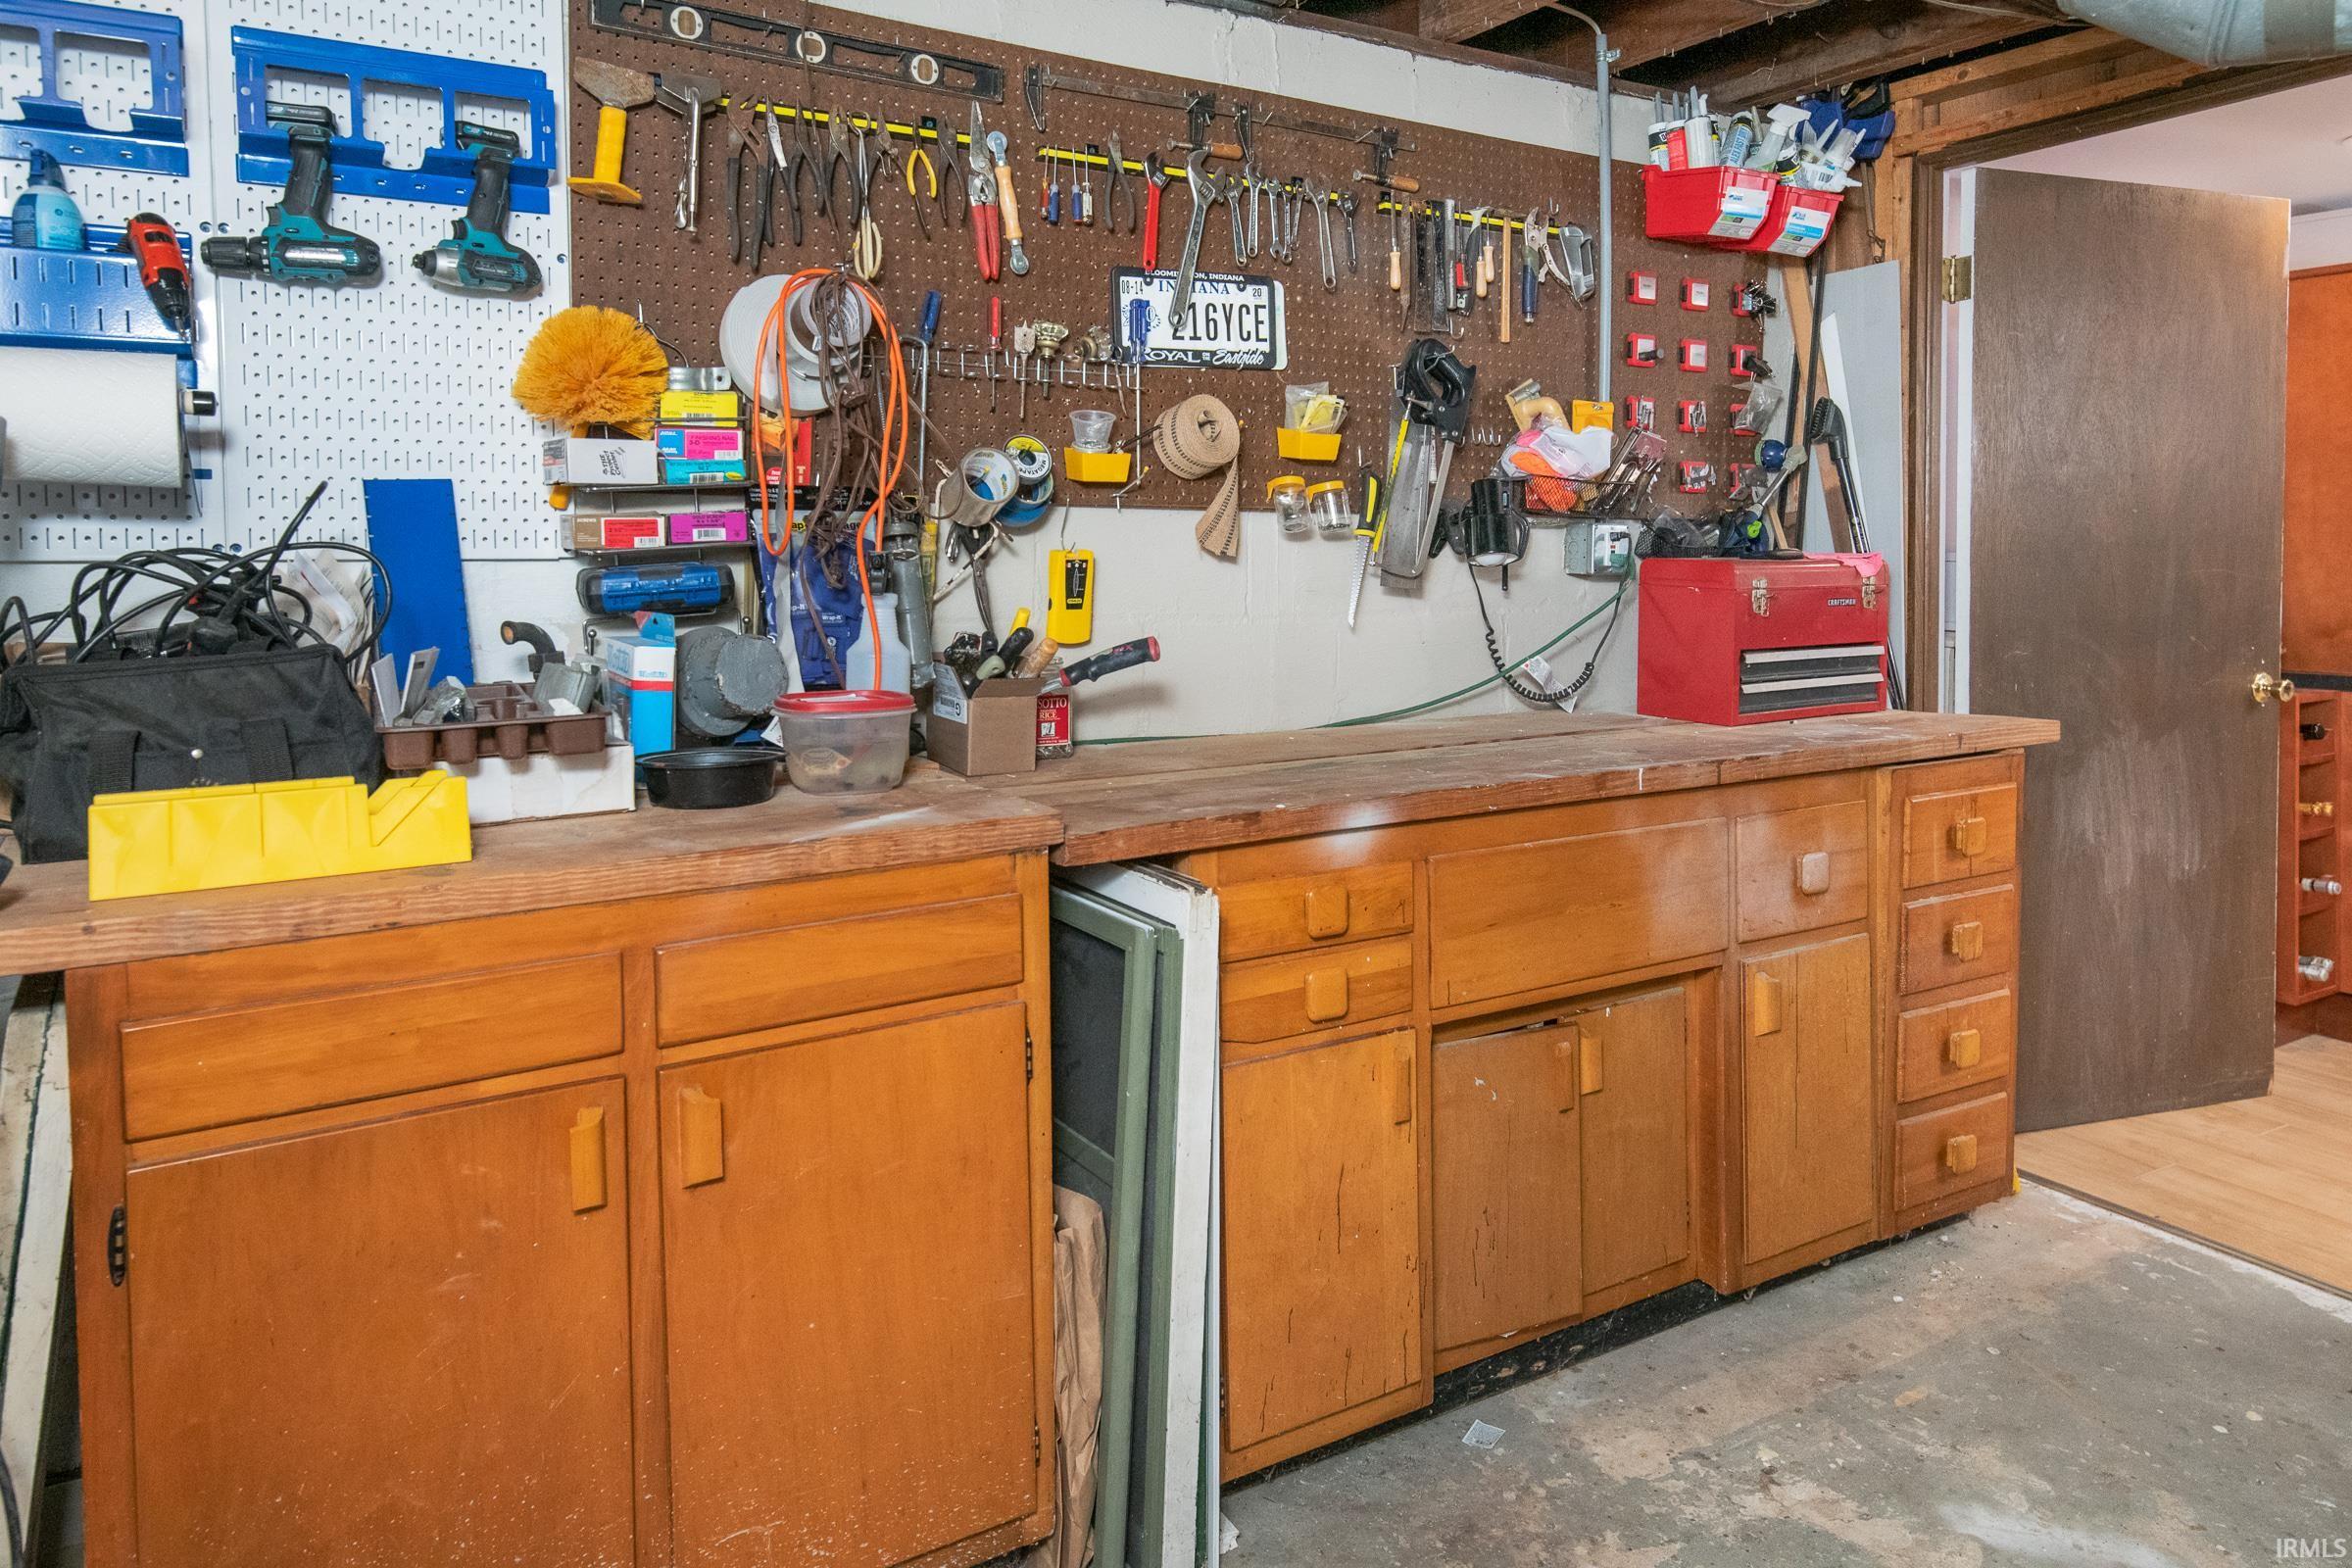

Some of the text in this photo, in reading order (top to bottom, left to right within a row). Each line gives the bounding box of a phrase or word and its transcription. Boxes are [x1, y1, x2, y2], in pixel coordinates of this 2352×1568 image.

[1145, 270, 1207, 279] BLOOMION,
[1158, 280, 1230, 294] INIANA
[1252, 287, 1262, 298] 20
